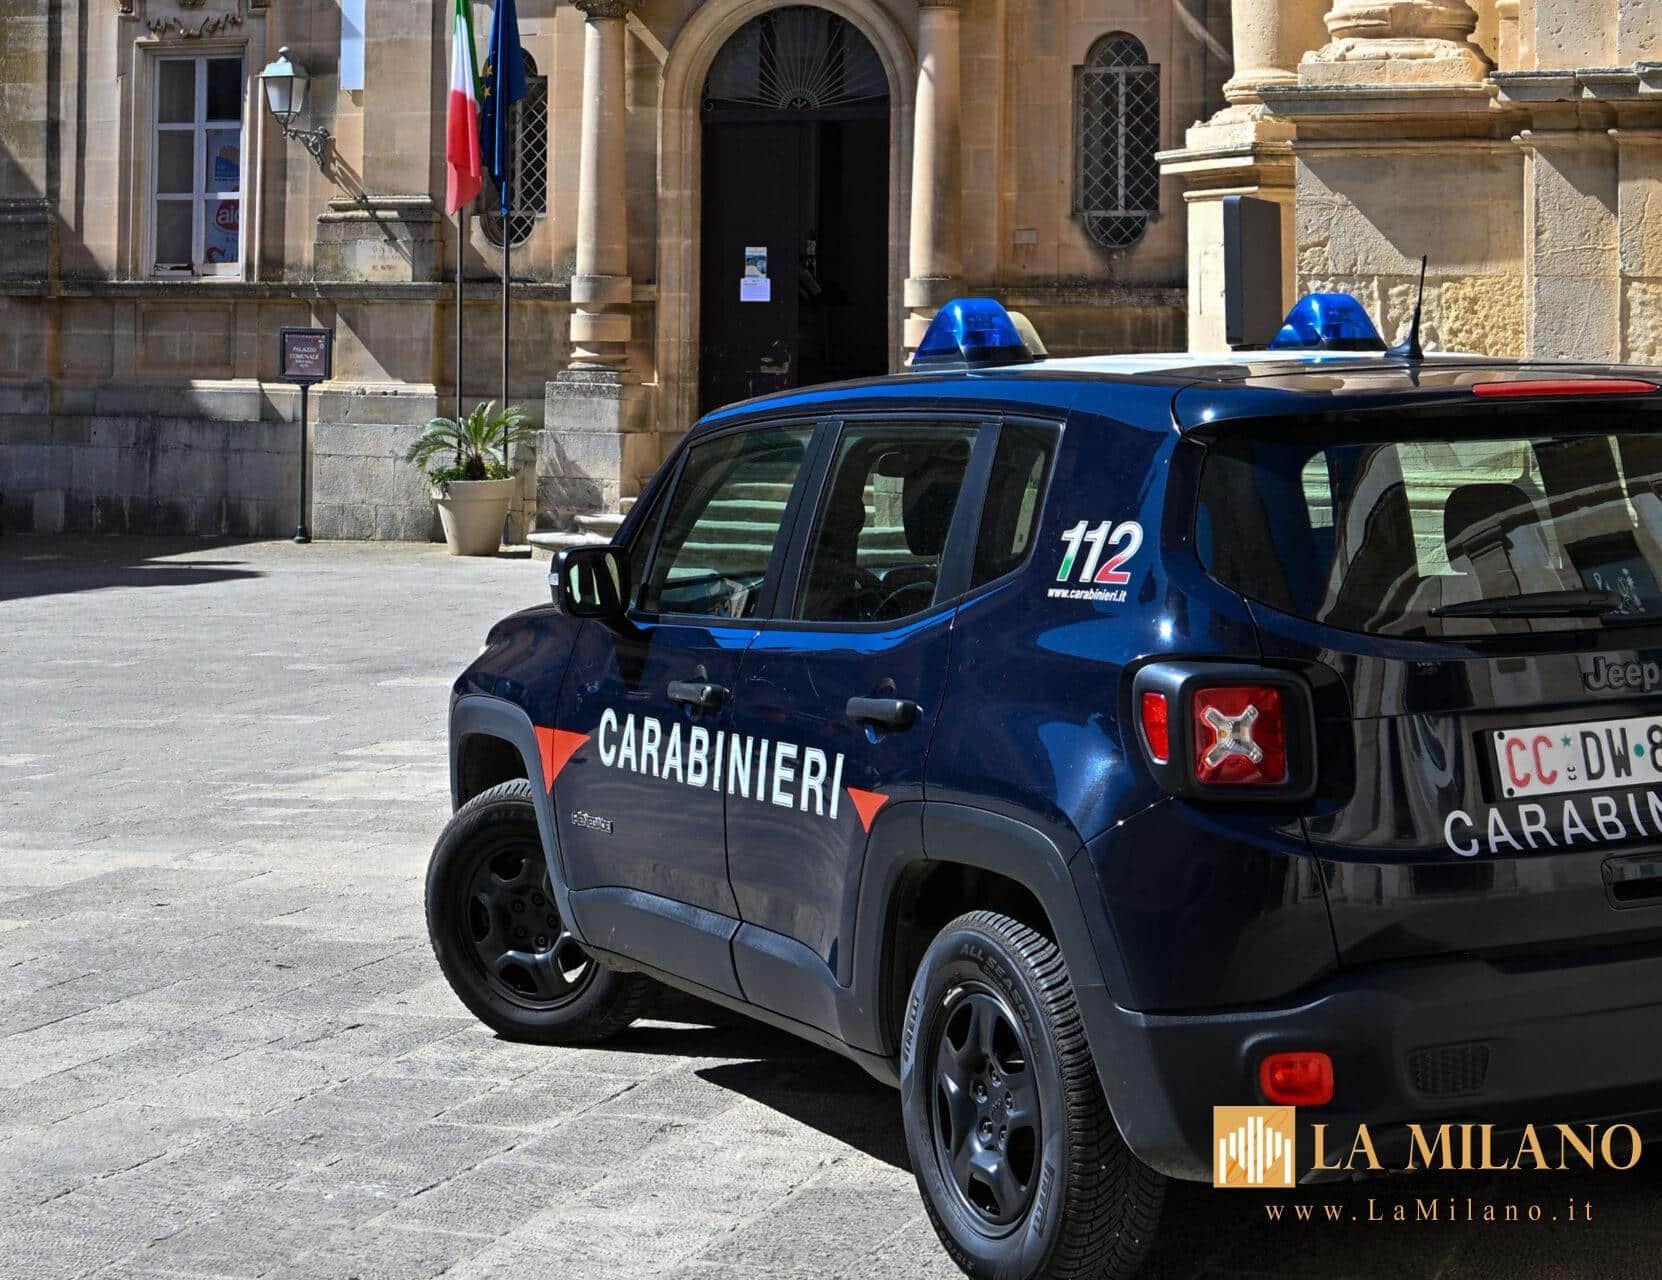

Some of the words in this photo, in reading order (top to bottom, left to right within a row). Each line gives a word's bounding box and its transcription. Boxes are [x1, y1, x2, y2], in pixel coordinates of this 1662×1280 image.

[1056, 519, 1144, 585] 112
[1047, 588, 1127, 603] www.carabinieri.it
[1584, 655, 1660, 693] Jeep
[598, 706, 845, 820] CARABINIERI
[1505, 735, 1558, 788] CC
